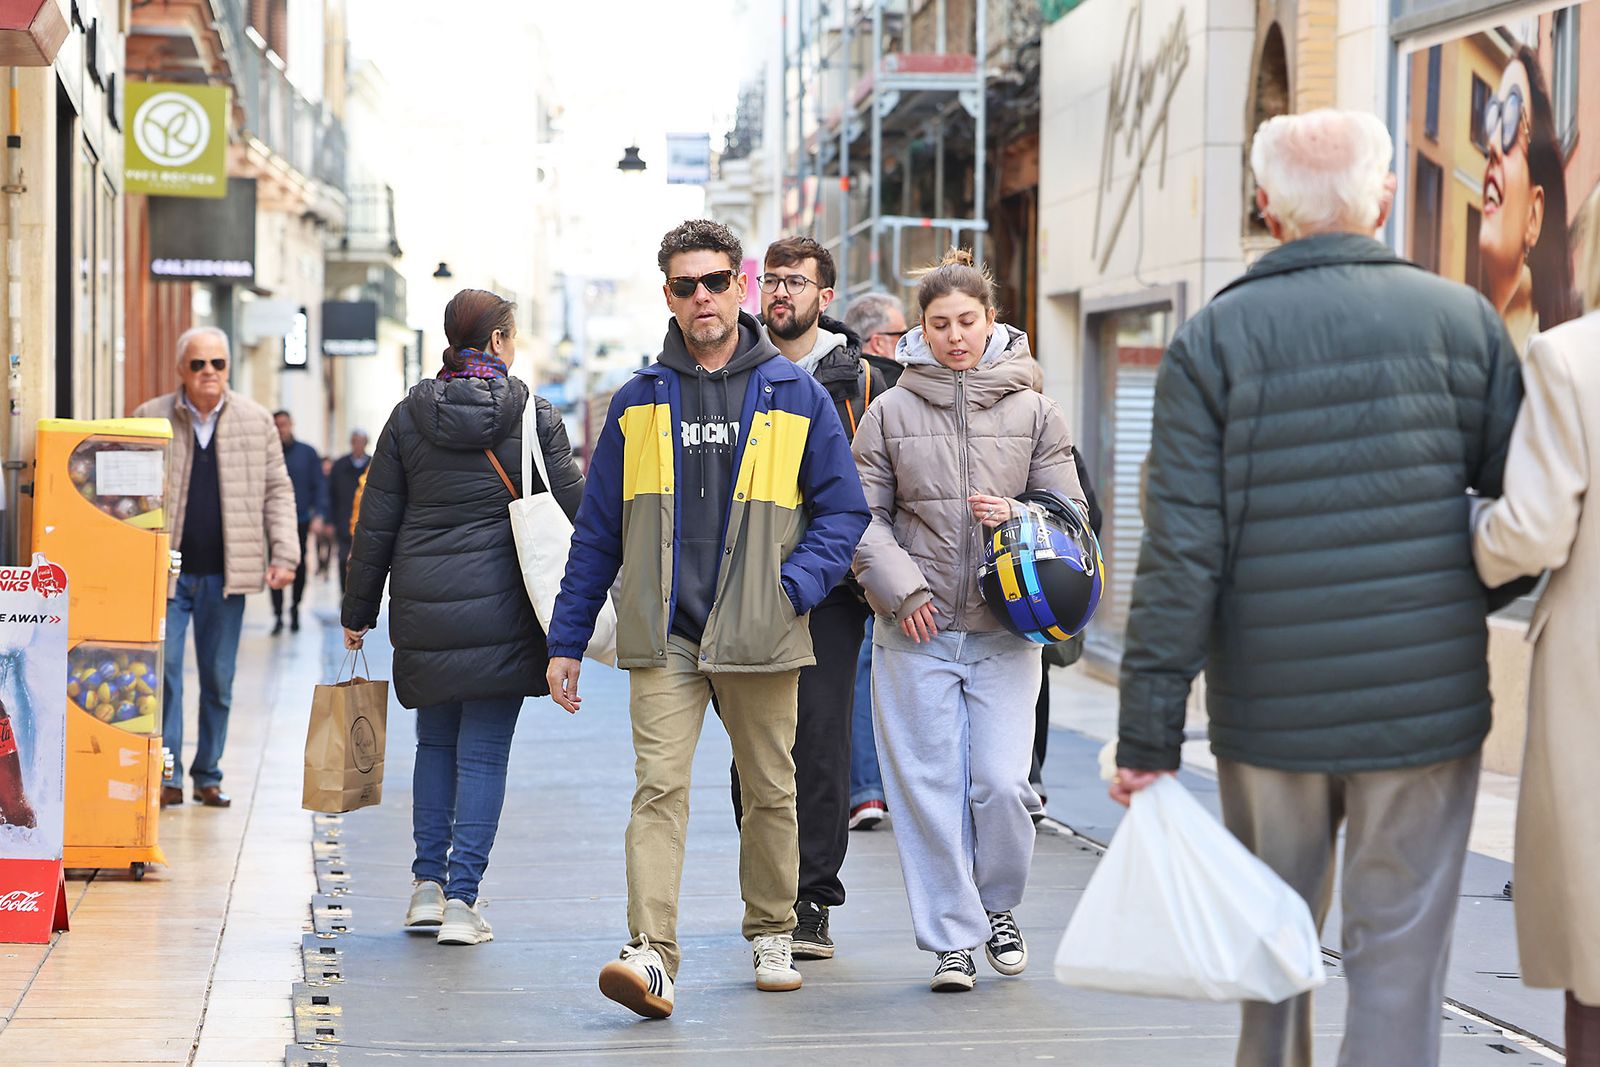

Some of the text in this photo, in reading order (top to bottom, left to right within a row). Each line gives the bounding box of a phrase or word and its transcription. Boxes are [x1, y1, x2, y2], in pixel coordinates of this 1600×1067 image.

[681, 420, 740, 447] ROCKY
[0, 569, 31, 580] OLD
[8, 614, 47, 623] AWAY
